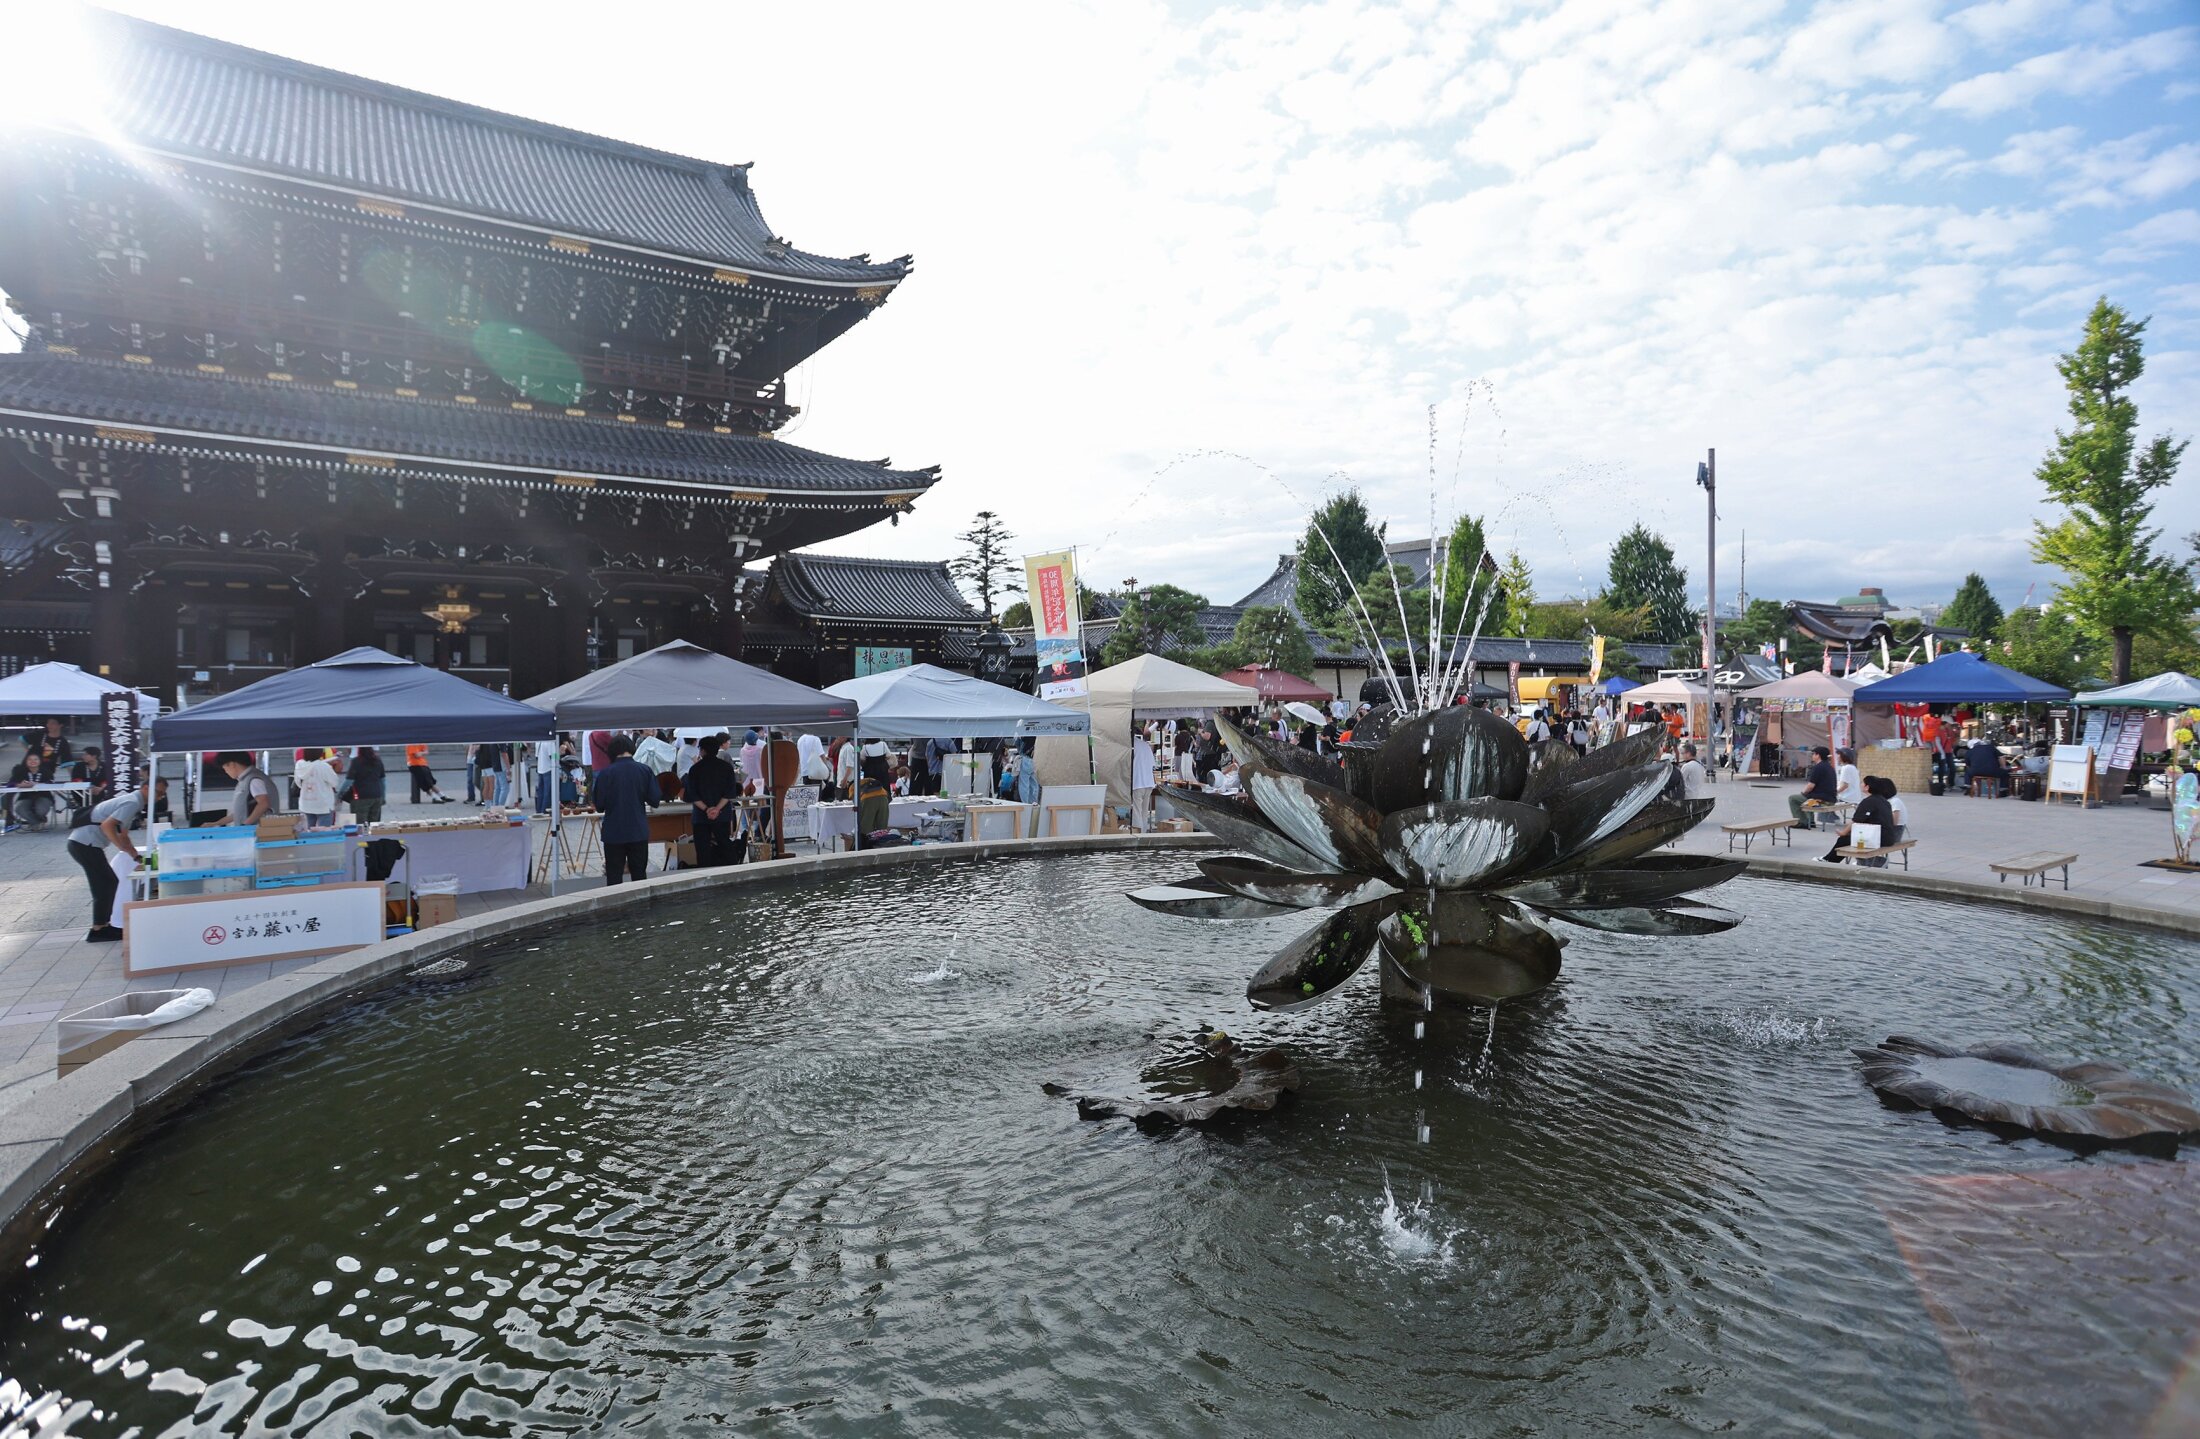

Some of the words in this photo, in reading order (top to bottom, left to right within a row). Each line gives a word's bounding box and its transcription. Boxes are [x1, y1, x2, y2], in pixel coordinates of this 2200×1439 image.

[862, 649, 905, 665] 報恩講
[234, 909, 298, 922] 大正十四年創業
